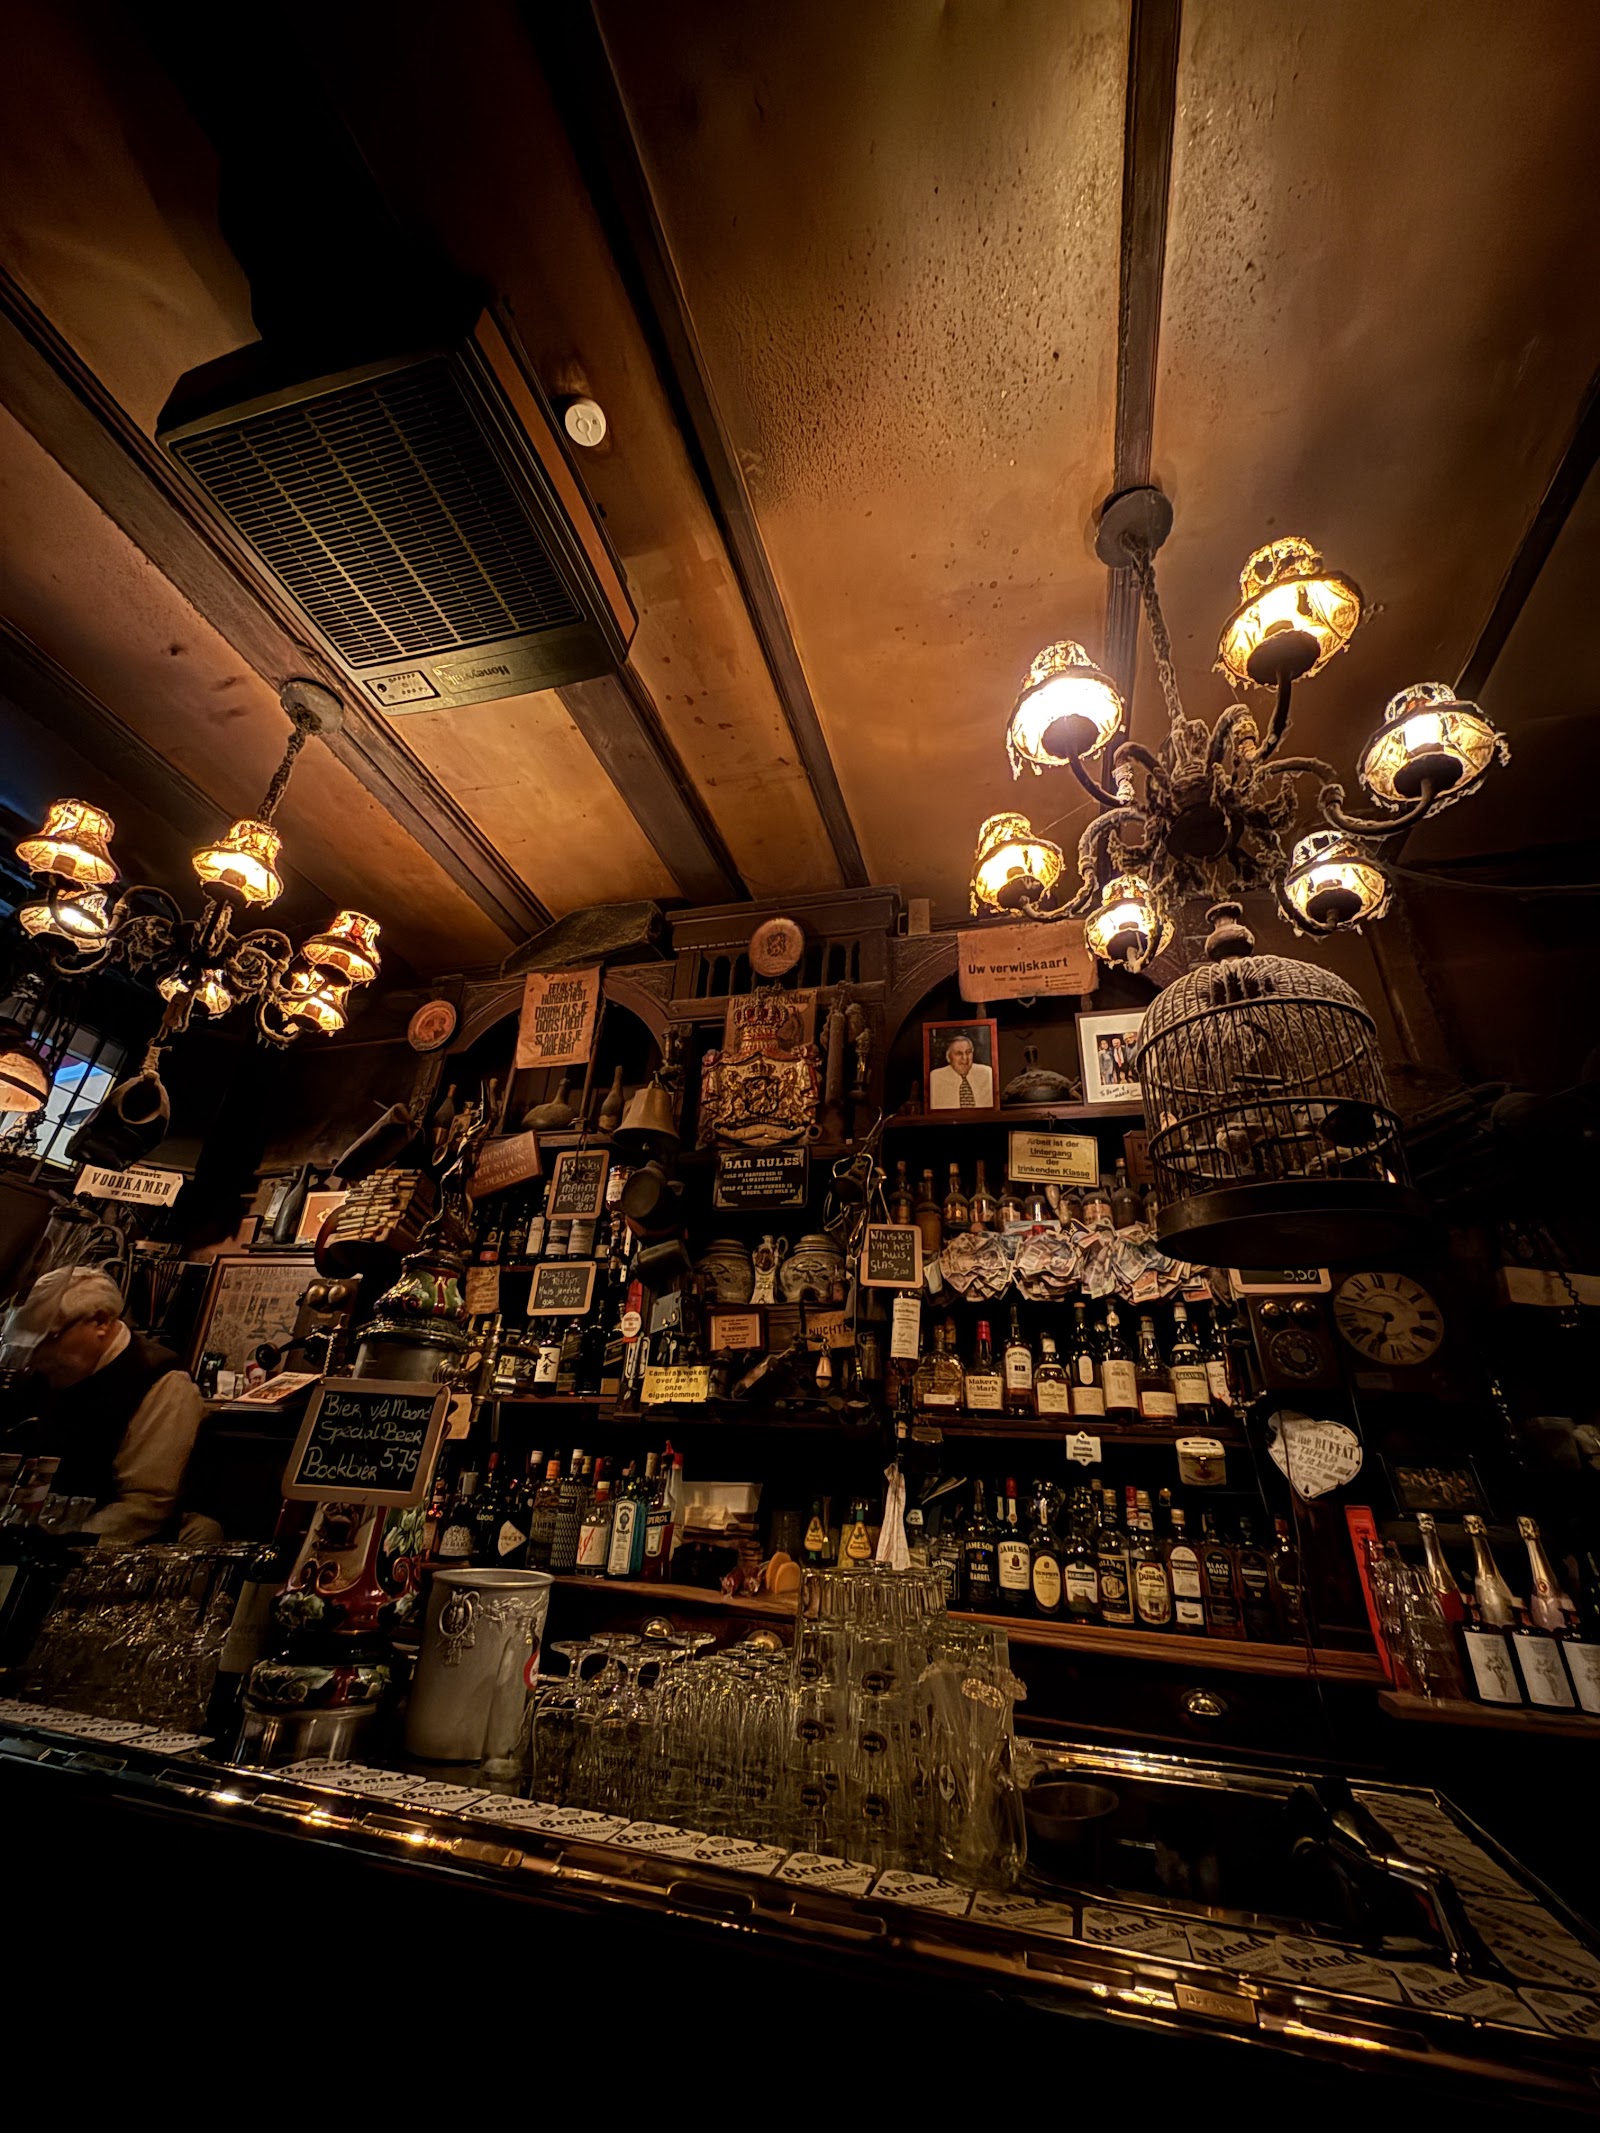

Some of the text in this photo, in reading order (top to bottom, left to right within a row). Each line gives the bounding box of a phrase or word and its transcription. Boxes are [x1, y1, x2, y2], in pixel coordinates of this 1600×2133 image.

[968, 957, 1069, 975] Uw verwijskaart
[560, 981, 574, 992] ALS
[574, 980, 583, 990] JE
[535, 1001, 589, 1020] DRINK ALS JE
[535, 1015, 584, 1033] DORST HEBT
[535, 1029, 582, 1046] SLAAP ALS JE
[1027, 1137, 1051, 1146] Arbeit
[1053, 1138, 1063, 1147] ist
[1030, 1148, 1072, 1158] Untergang
[724, 1157, 799, 1169] BAR RULES
[1017, 1165, 1090, 1177] trinkenden Klasse
[92, 1172, 171, 1195] VOORKAMER
[870, 1230, 912, 1242] Whisky
[809, 1324, 854, 1337] NUCHTE
[968, 1378, 998, 1386] Maker's
[648, 1392, 700, 1400] eigendommen
[324, 1394, 362, 1418] Bier
[318, 1420, 422, 1445] Special Beer
[303, 1446, 377, 1481] Bockbier
[965, 1541, 994, 1551] JAMESON
[1000, 1545, 1029, 1555] JAMESON
[971, 1563, 989, 1572] BLACK
[1206, 1561, 1229, 1571] BLACK
[969, 1572, 991, 1582] BARREL
[279, 1760, 355, 1775] Brand
[337, 1773, 410, 1787] Brand
[402, 1787, 475, 1799] Brand
[469, 1800, 542, 1815] Brand
[539, 1814, 614, 1829] Brand
[615, 1829, 688, 1844] Brand
[694, 1842, 769, 1861] Brand
[783, 1860, 859, 1879] Brand
[877, 1878, 954, 1898] Brand
[976, 1899, 1049, 1916] Brand
[1085, 1916, 1163, 1941] Brand
[1194, 1934, 1270, 1963] Brand
[1282, 1950, 1368, 1973] Brand
[1410, 1974, 1488, 2006] Brand
